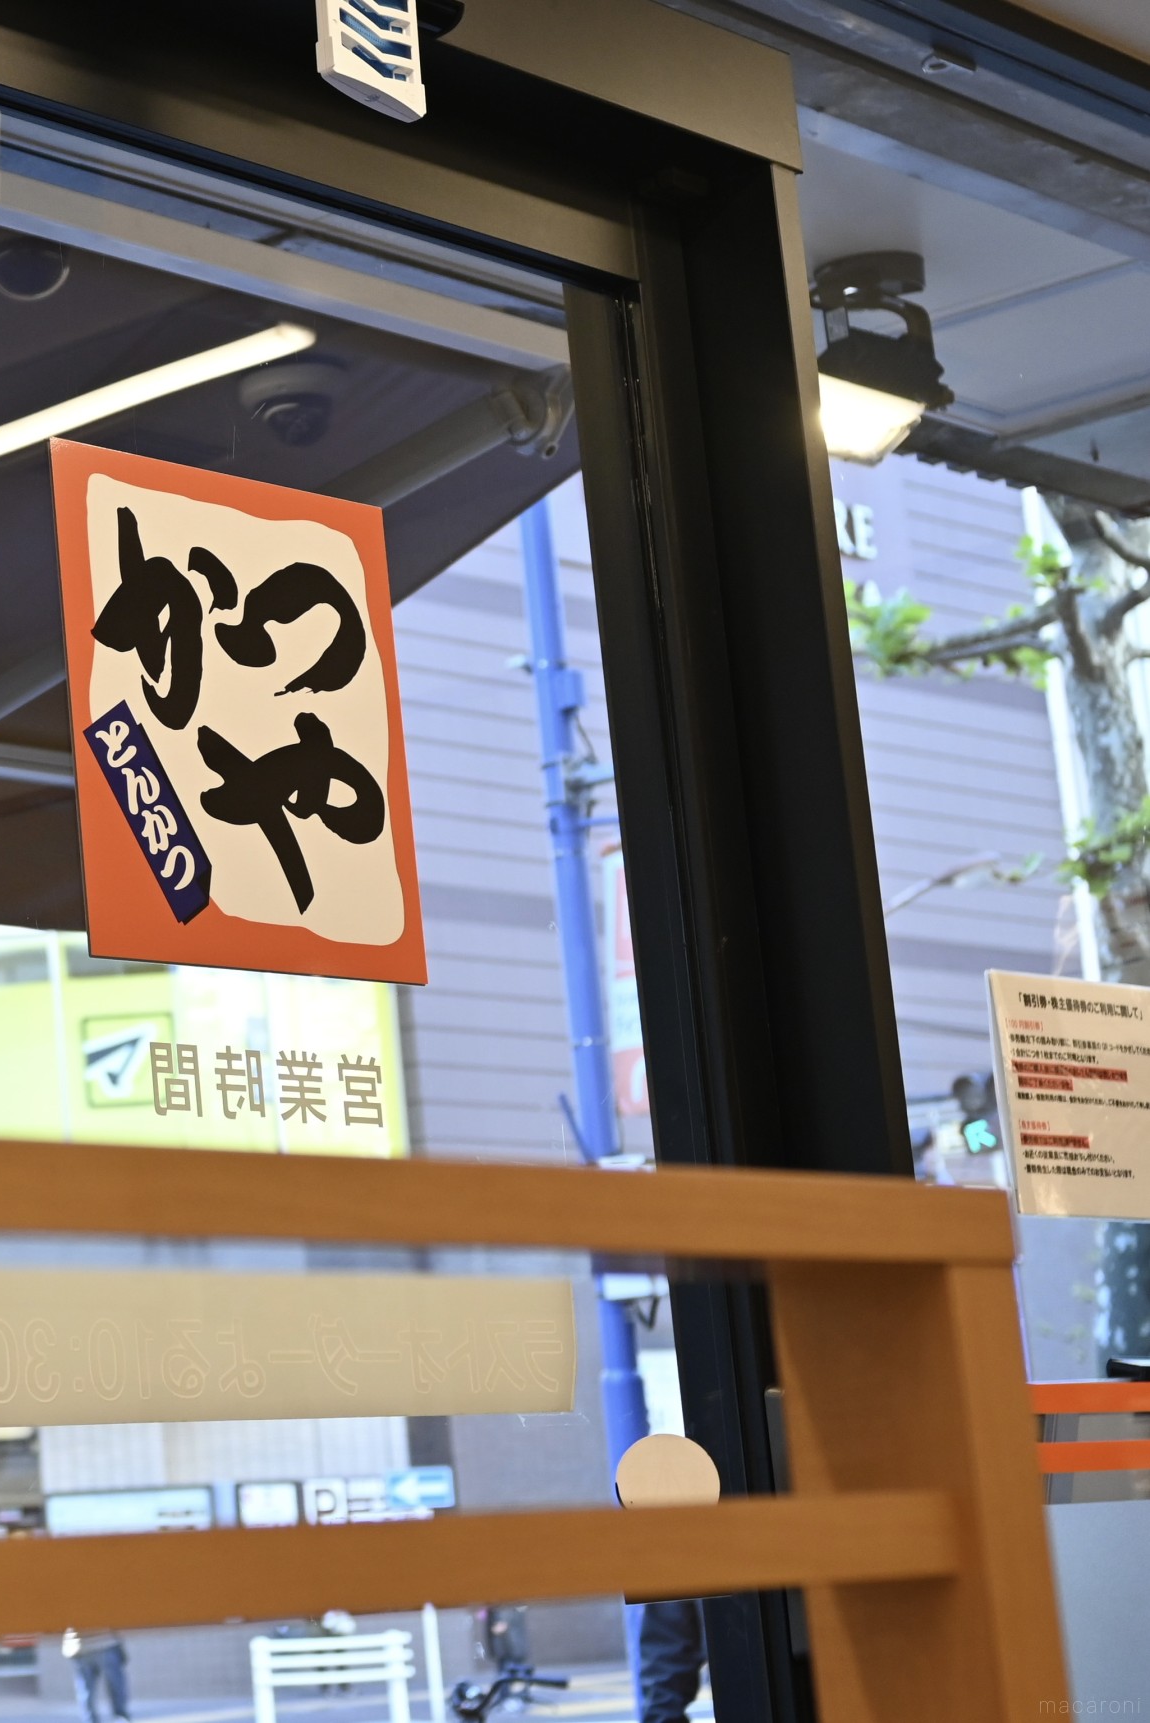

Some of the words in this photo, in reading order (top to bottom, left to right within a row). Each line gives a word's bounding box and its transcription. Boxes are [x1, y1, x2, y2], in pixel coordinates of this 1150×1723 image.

[90, 506, 386, 915] かつや
[94, 719, 196, 891] とんかつ
